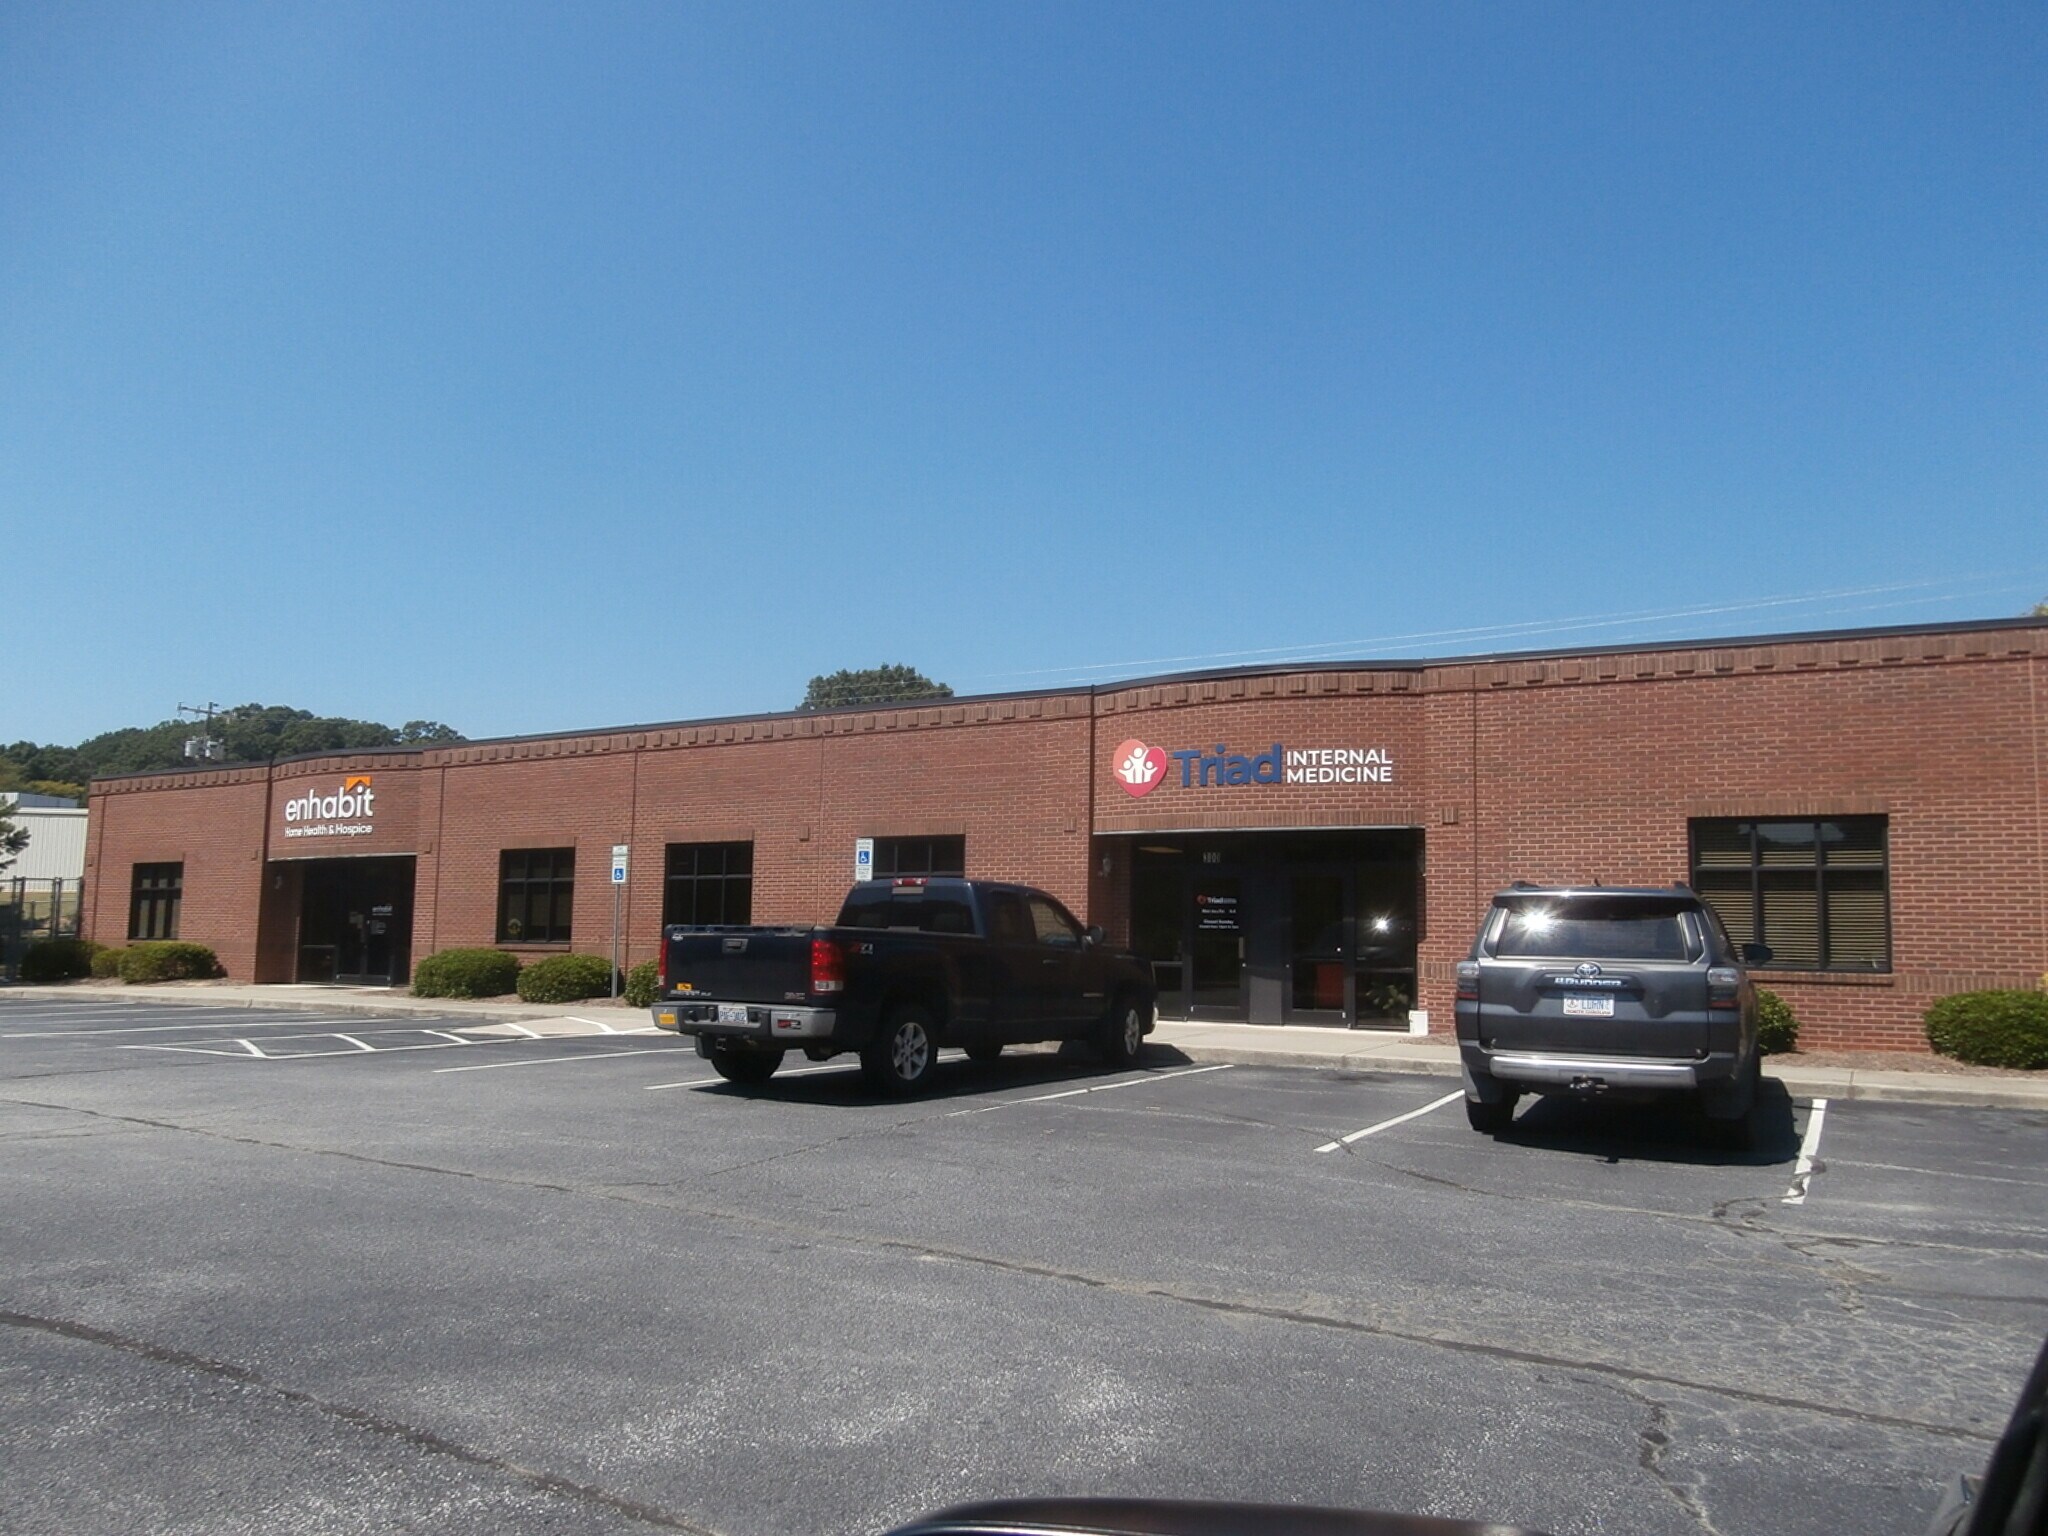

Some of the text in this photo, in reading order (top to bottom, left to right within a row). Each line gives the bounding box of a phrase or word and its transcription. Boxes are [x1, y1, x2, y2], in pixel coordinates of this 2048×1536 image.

[1173, 744, 1282, 787] Triad
[1287, 749, 1393, 766] INTERNAL
[1287, 766, 1392, 784] MEDICINE
[285, 786, 375, 821] enhabit
[285, 823, 373, 837] Home Health & Hospice
